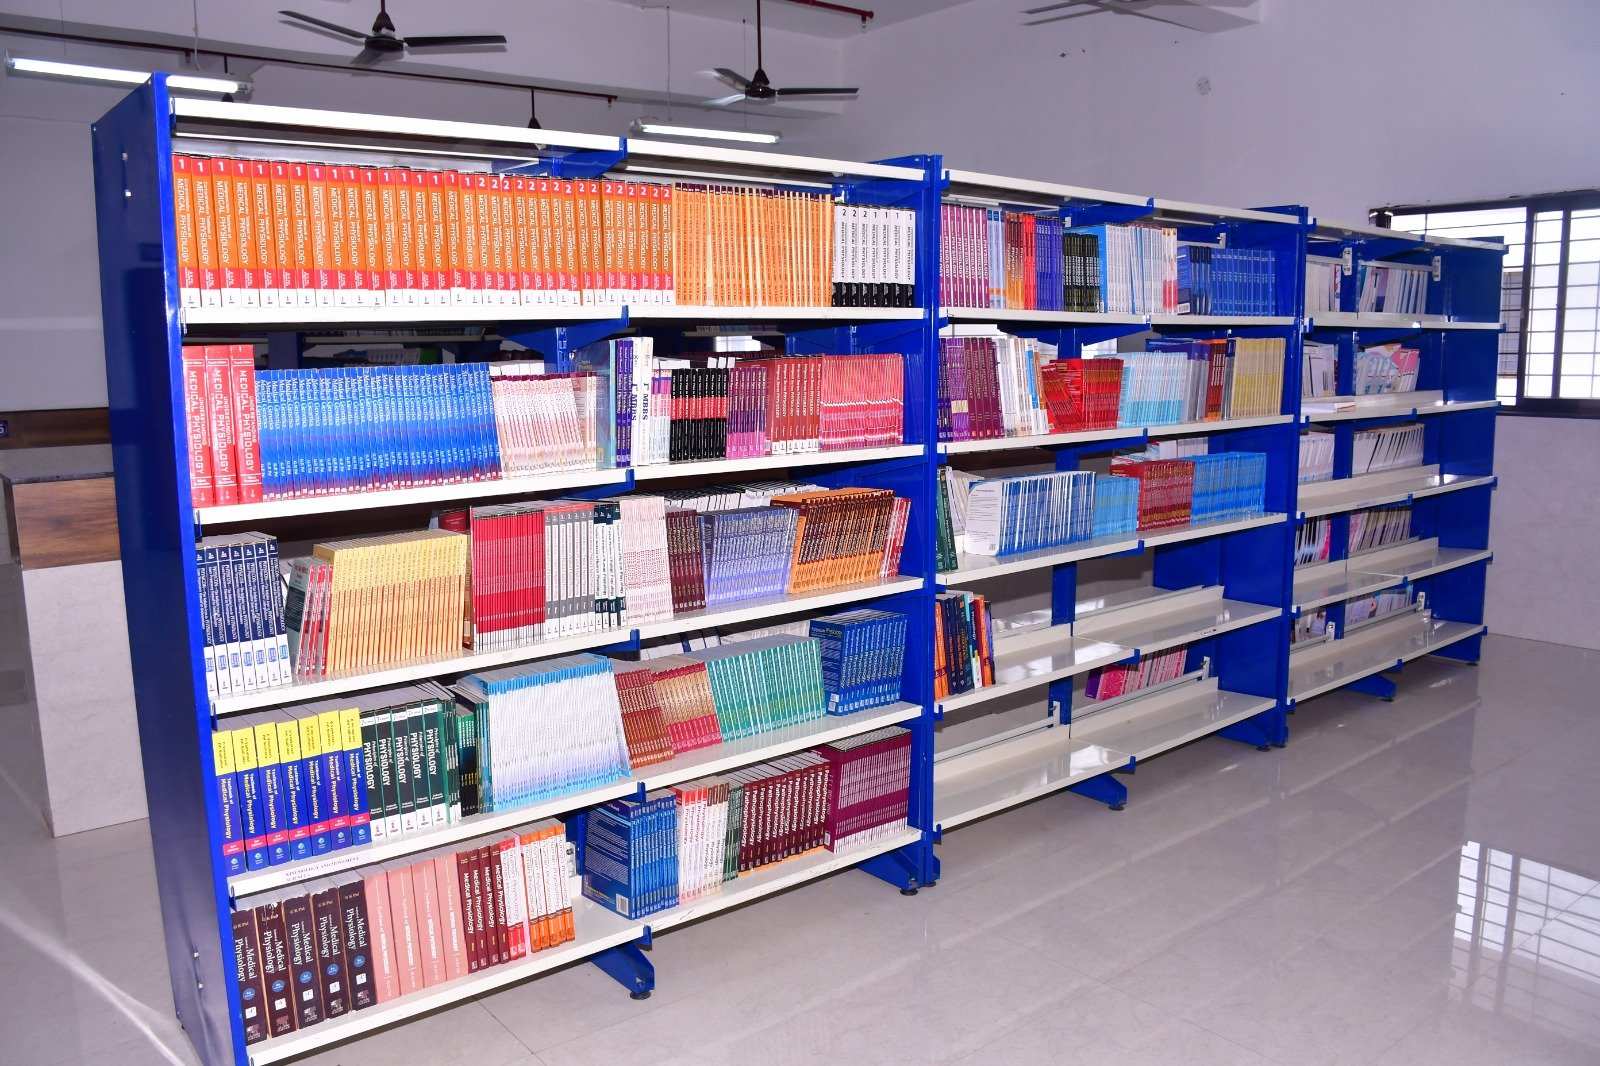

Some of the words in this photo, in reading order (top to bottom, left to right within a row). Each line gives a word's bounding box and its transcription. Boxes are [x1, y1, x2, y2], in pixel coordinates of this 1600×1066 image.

[179, 159, 184, 169] 1
[198, 162, 203, 172] 1
[219, 161, 224, 171] 1
[238, 164, 244, 174] 1
[258, 164, 262, 175] 1
[277, 165, 282, 175] 1
[296, 166, 300, 176] 1
[315, 168, 319, 179] 1
[332, 169, 337, 179] 1
[350, 170, 355, 179] 1
[367, 172, 371, 182] 1
[384, 172, 389, 182] 1
[402, 172, 406, 182] 1
[417, 174, 422, 183] 1
[433, 175, 438, 184] 1
[450, 174, 455, 183] 1
[465, 177, 470, 186] 1
[479, 178, 485, 186] 2
[492, 179, 498, 188] 2
[504, 181, 509, 190] 2
[517, 181, 522, 189] 2
[529, 181, 535, 190] 2
[541, 182, 547, 191] 2
[554, 182, 559, 191] 2
[566, 185, 571, 193] 2
[580, 183, 584, 192] 2
[591, 184, 597, 192] 2
[606, 184, 612, 193] 2
[618, 185, 623, 193] 2
[628, 187, 634, 195] 2
[641, 187, 647, 195] 2
[195, 181, 204, 213] MEDICAL
[216, 181, 225, 212] MEDICAL
[256, 184, 264, 216] MEDICAL
[294, 185, 302, 217] MEDICAL
[312, 186, 320, 219] MEDICAL
[653, 189, 658, 197] 2
[664, 189, 670, 197] 2
[214, 369, 224, 410] MEDICAL
[239, 370, 249, 410] MEDICAL
[189, 371, 199, 412] MEDICAL
[194, 415, 203, 474] PHYSIOLOGY
[218, 414, 229, 472] PHYSIOLOGY
[243, 413, 254, 471] PHYSIOLOGY
[379, 739, 390, 786] PHYSIOLOGY
[395, 737, 406, 784] PHYSIOLOGY
[410, 732, 421, 779] PHYSIOLOGY
[426, 729, 436, 775] PHYSIOLOGY
[364, 742, 375, 789] PHYSIOLOGY
[311, 786, 319, 818] Physiology
[352, 778, 360, 810] Physiology
[247, 800, 255, 833] Physiology
[269, 795, 277, 829] Physiology
[290, 791, 298, 824] Physiology
[223, 804, 232, 839] Physiology
[462, 872, 471, 898] Medical
[472, 870, 481, 895] Medical
[484, 866, 493, 893] Medical
[495, 864, 503, 890] Medical
[464, 899, 475, 934] Physiology
[473, 896, 483, 931] Physiology
[486, 893, 495, 928] Physiology
[497, 890, 507, 925] Physiology
[319, 916, 331, 958] Physiology
[330, 926, 340, 955] Medical
[345, 908, 357, 950] Physiology
[356, 918, 367, 947] Medical
[263, 930, 276, 974] Physiology
[275, 940, 286, 972] Medical
[291, 922, 303, 965] Physiology
[302, 932, 313, 962] Medical
[234, 938, 247, 982] Physiology
[246, 948, 257, 979] Medical
